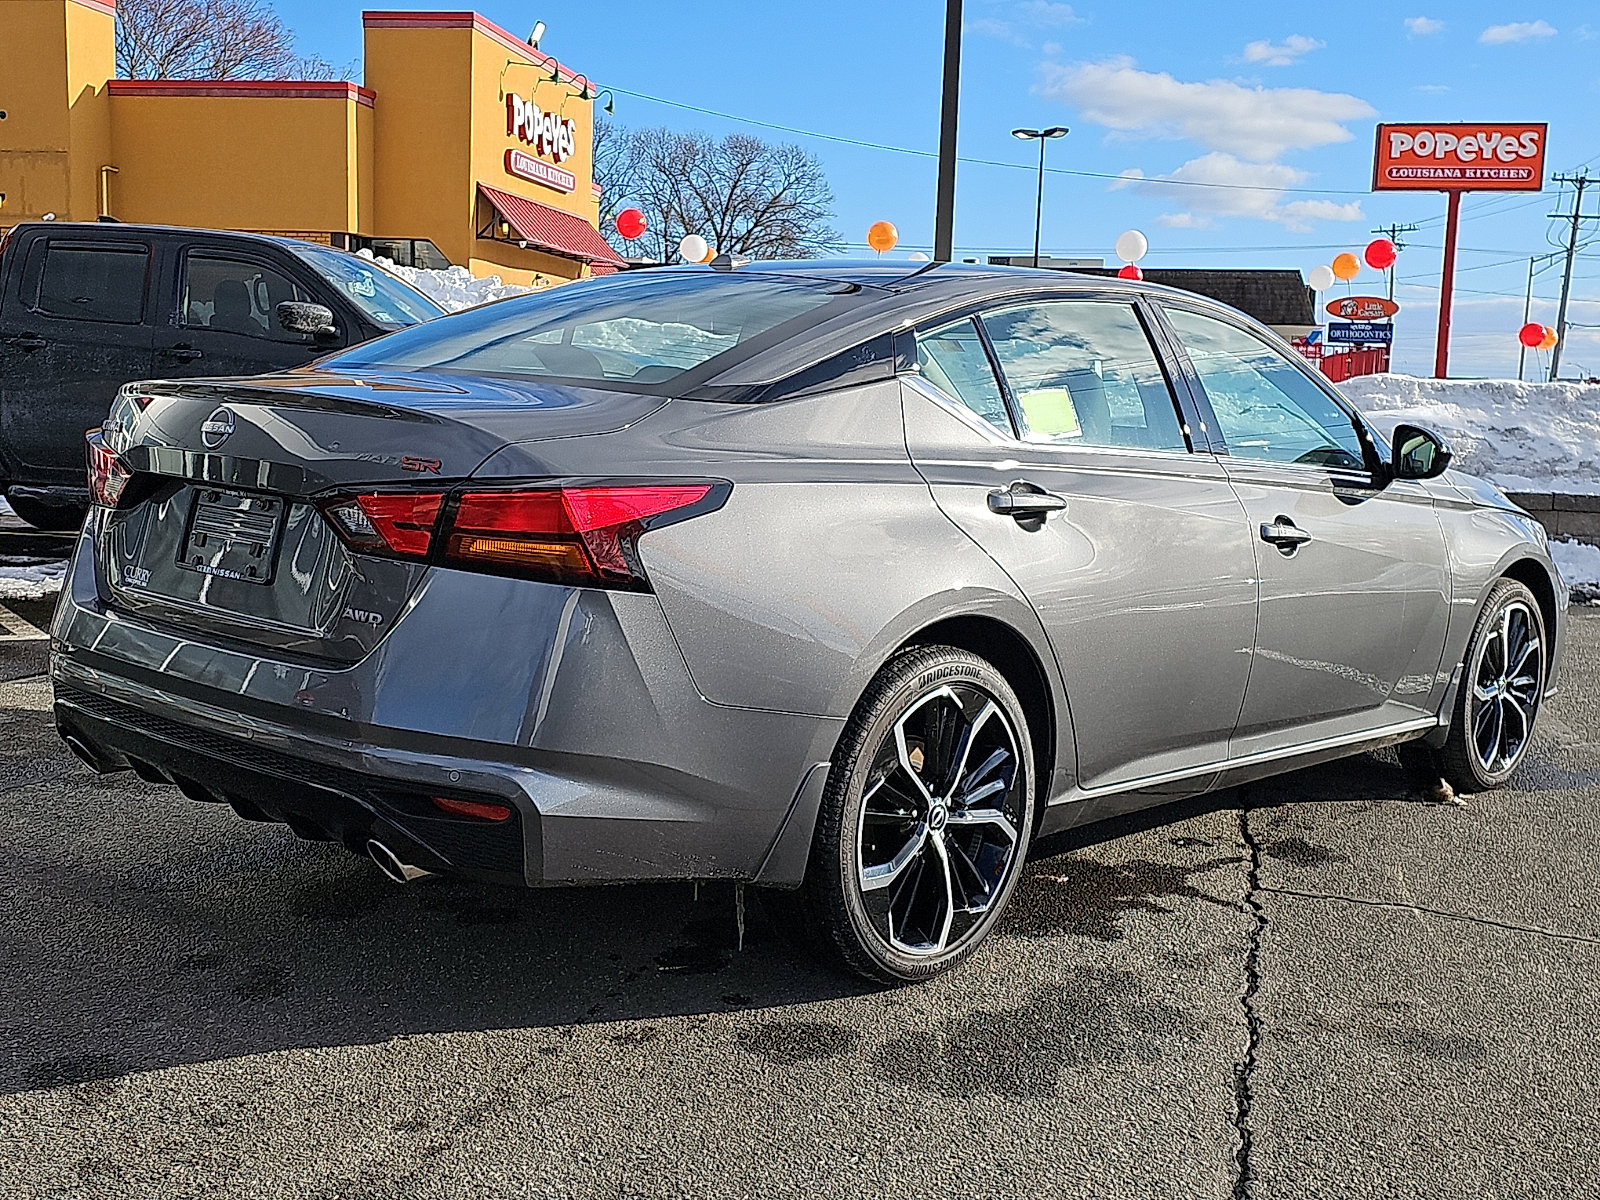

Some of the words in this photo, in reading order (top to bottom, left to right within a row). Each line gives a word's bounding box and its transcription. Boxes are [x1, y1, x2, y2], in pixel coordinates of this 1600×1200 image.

[1391, 168, 1461, 178] LOUISIANA
[1465, 168, 1529, 178] KITCHEN
[1330, 329, 1392, 339] ORTHODONTICS
[401, 455, 442, 476] SR
[123, 564, 153, 583] CURRY
[212, 567, 241, 580] NISSAN
[342, 606, 384, 625] AWD
[917, 665, 983, 691] BRIDGESTONE
